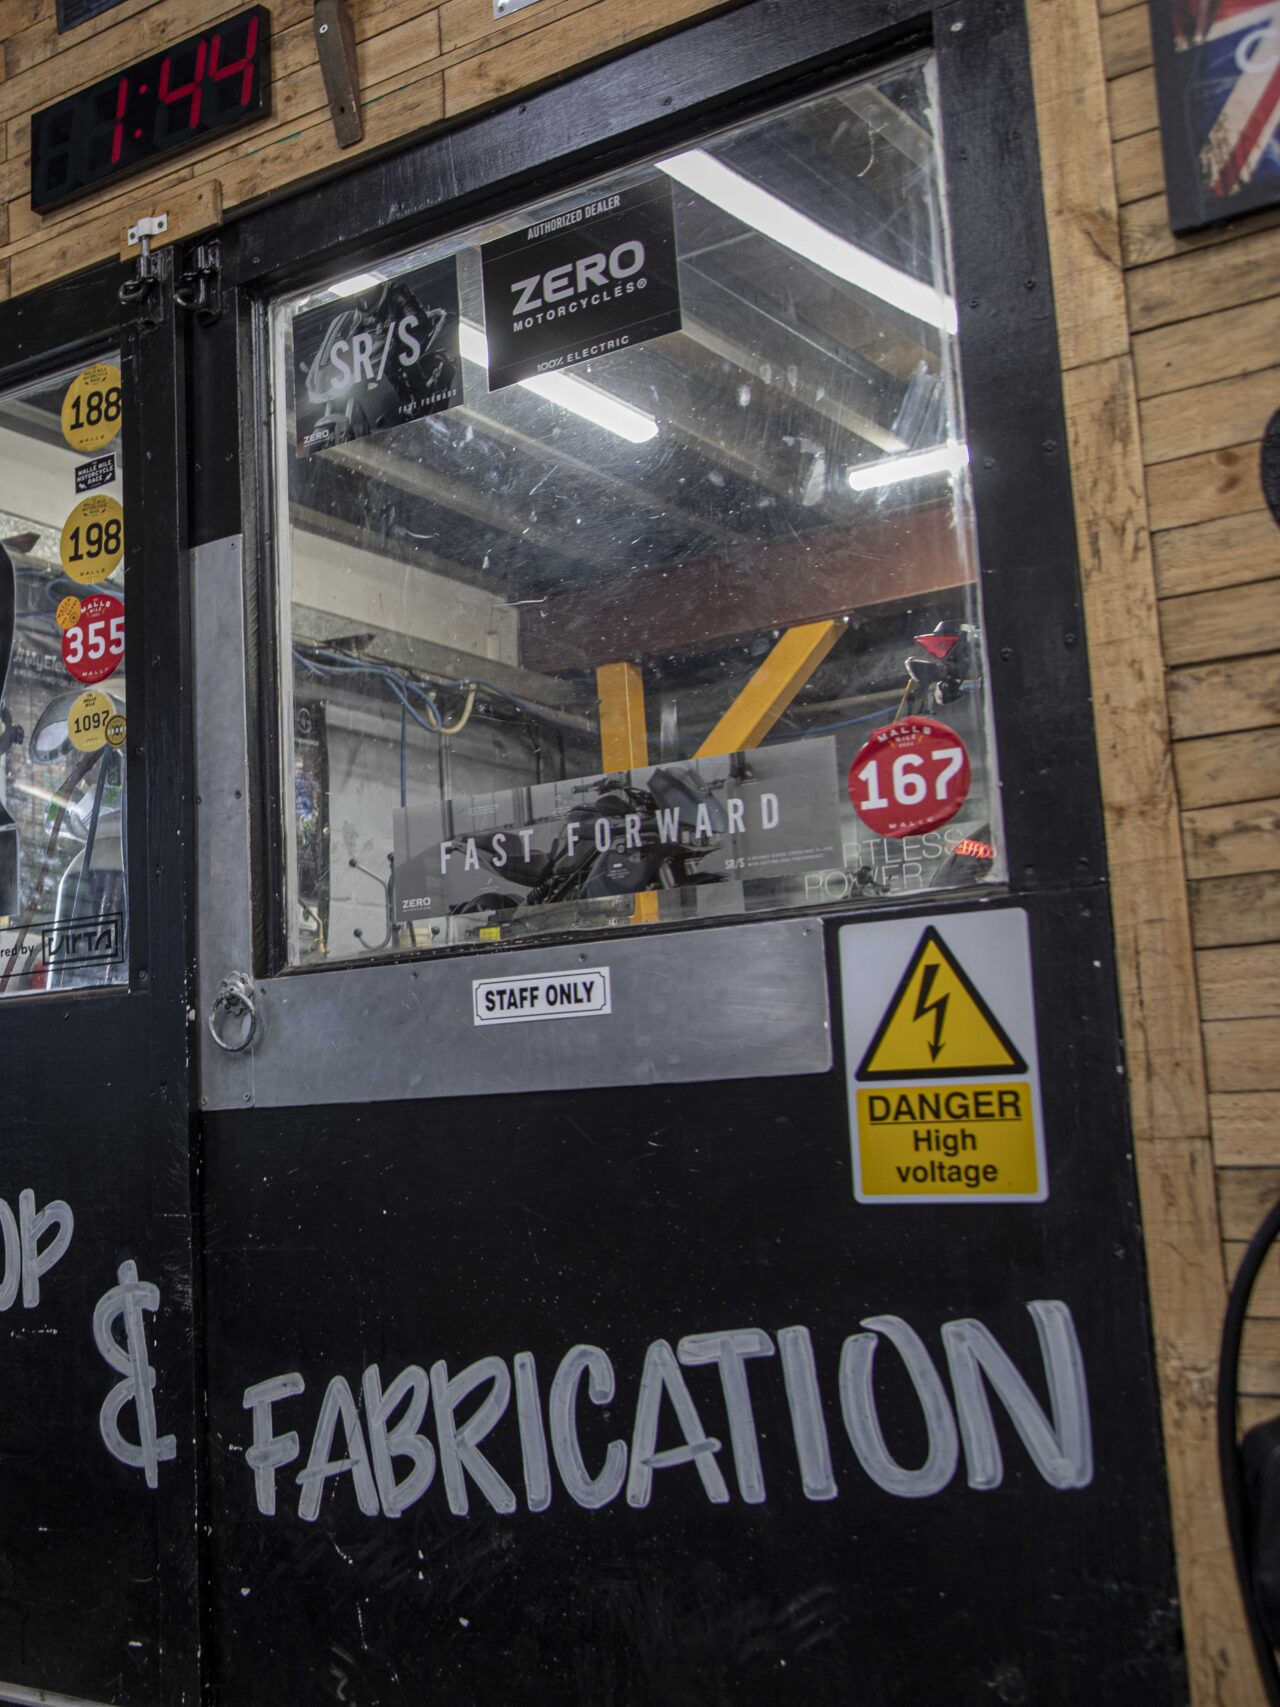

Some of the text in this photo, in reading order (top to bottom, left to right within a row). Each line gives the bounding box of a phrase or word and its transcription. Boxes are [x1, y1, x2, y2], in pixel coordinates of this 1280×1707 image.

[111, 15, 259, 165] 1:44
[527, 195, 621, 240] AUTHORIZED DEALER
[510, 240, 646, 316] ZERO
[329, 314, 421, 390] SR/S
[536, 335, 631, 372] 100% ELECTRIC
[70, 386, 122, 430] 188
[398, 389, 458, 414] FAST FORWARD
[303, 428, 330, 445] ZERO
[77, 465, 113, 482] MOTORCYCLE
[78, 459, 112, 476] MALLE MILE
[88, 475, 103, 485] RACE
[69, 518, 122, 562] 198
[65, 616, 125, 664] 355
[74, 710, 110, 734] 1097
[877, 726, 932, 743] MALLE
[858, 747, 964, 811] 167
[440, 792, 780, 875] FAST FORWARD
[843, 828, 964, 868] RTLESS
[724, 857, 745, 870] SR/S
[402, 897, 431, 909] ZERO
[19, 943, 35, 959] by
[485, 981, 596, 1013] STAFF ONLY
[868, 1090, 1021, 1122] DANGER
[913, 1128, 977, 1159] High
[896, 1160, 998, 1187] voltage
[93, 1259, 177, 1488] &
[242, 1299, 1094, 1521] FABRICATION
